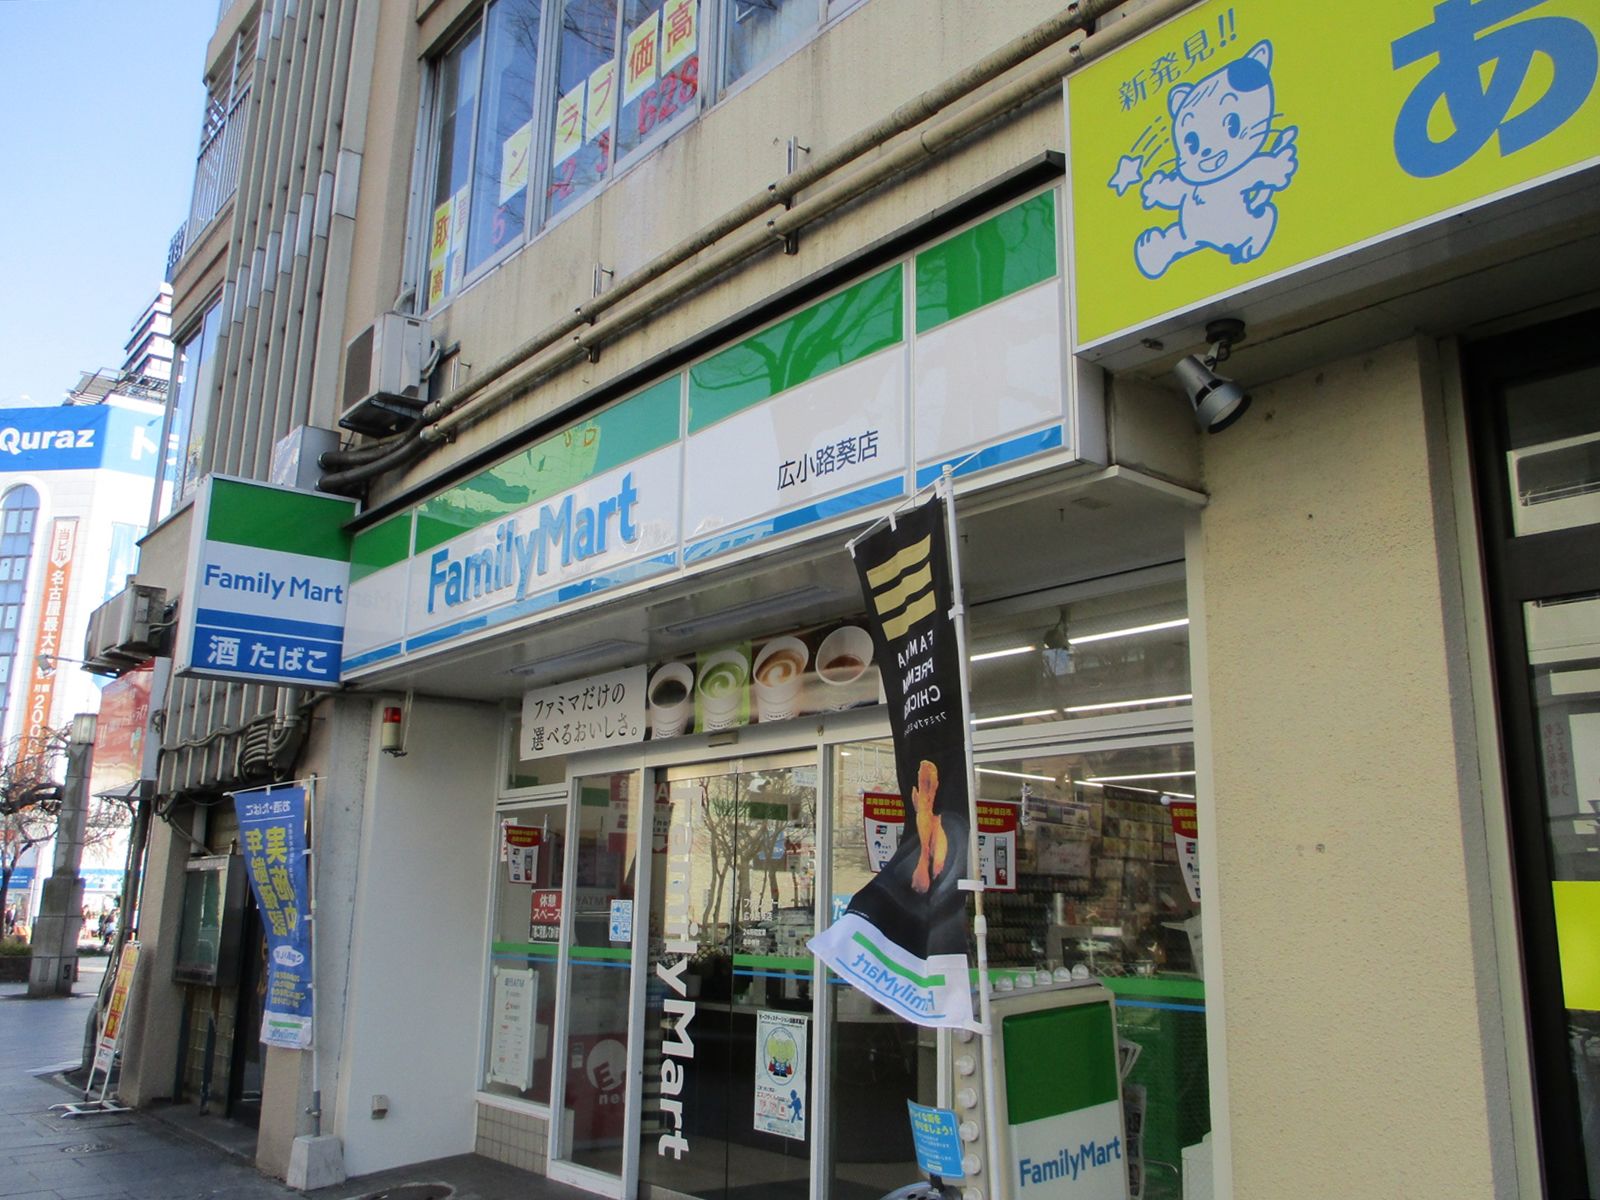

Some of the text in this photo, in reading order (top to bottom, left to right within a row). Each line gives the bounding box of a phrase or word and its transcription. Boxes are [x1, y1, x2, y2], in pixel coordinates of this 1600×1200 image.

[1391, 0, 1599, 179] あ
[0, 426, 95, 455] Quraz
[777, 430, 879, 491] 広小路葵店
[427, 471, 639, 614] FamilyMart
[204, 564, 343, 604] Family Mart
[207, 635, 327, 674] 酒 たばこ
[533, 682, 625, 720] ファミマだけの
[1019, 1136, 1121, 1188] FamilyMart
